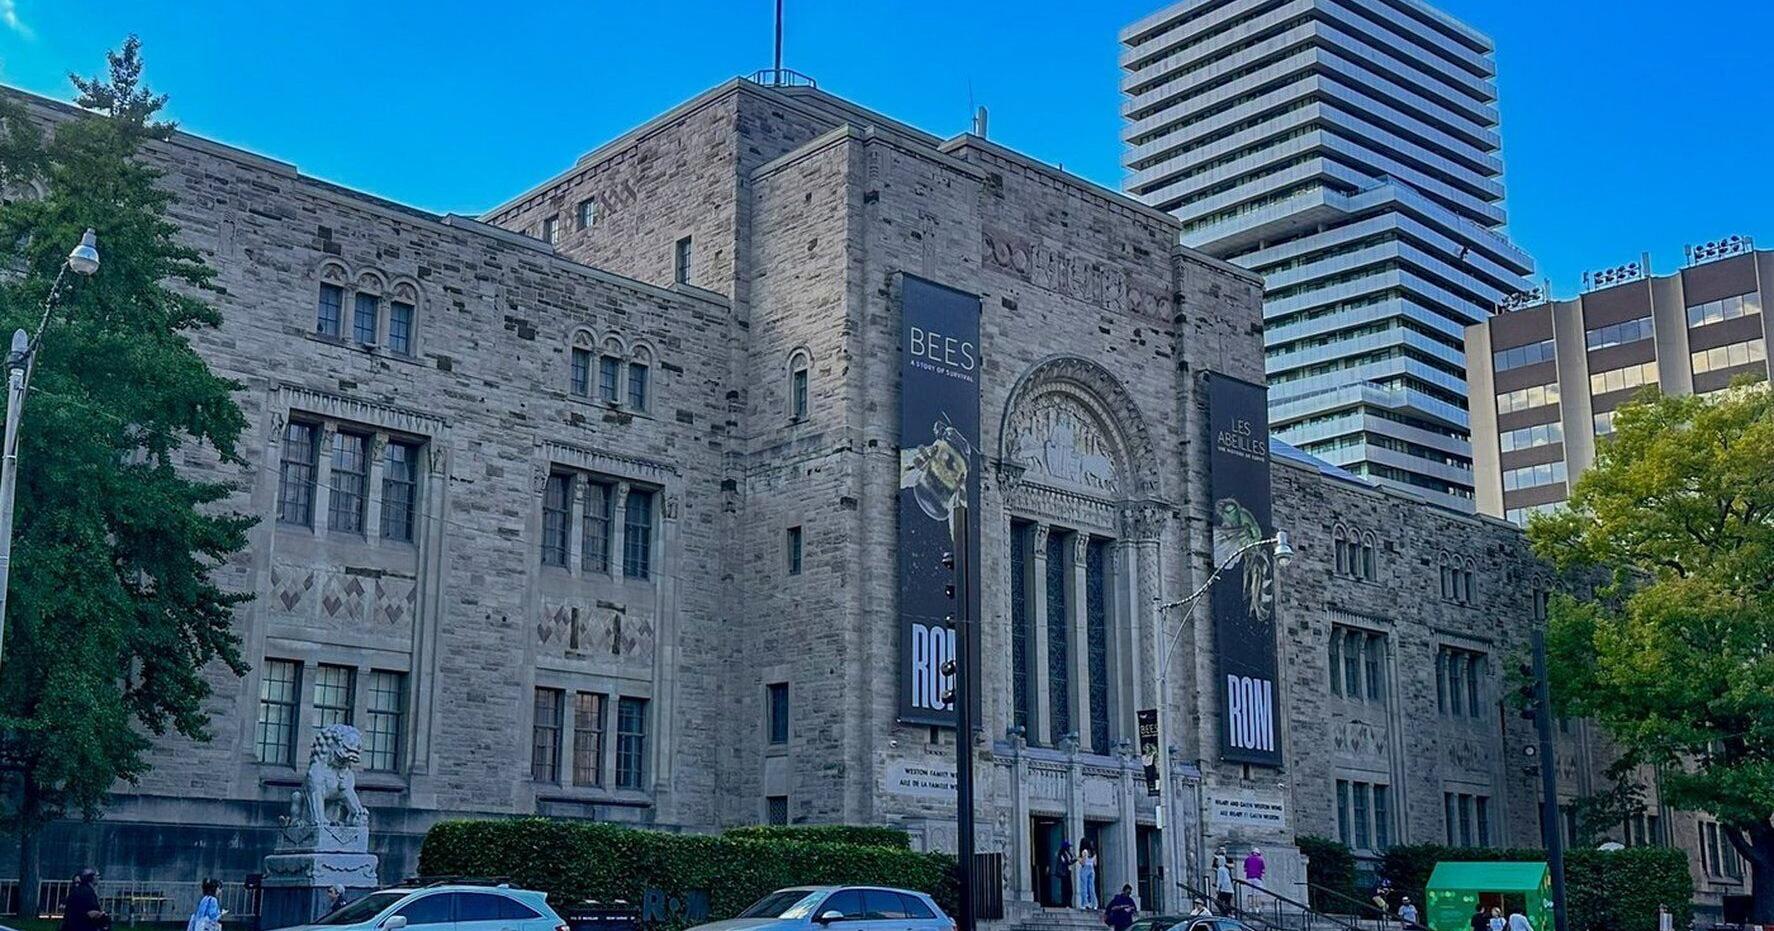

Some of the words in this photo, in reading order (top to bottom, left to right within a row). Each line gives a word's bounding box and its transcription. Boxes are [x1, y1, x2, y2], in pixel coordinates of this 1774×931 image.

[911, 327, 975, 370] BEES
[916, 361, 935, 371] STORY
[936, 366, 945, 374] OF
[1231, 416, 1251, 436] LES
[1217, 430, 1266, 456] ABEILLES
[1227, 674, 1274, 751] ROM
